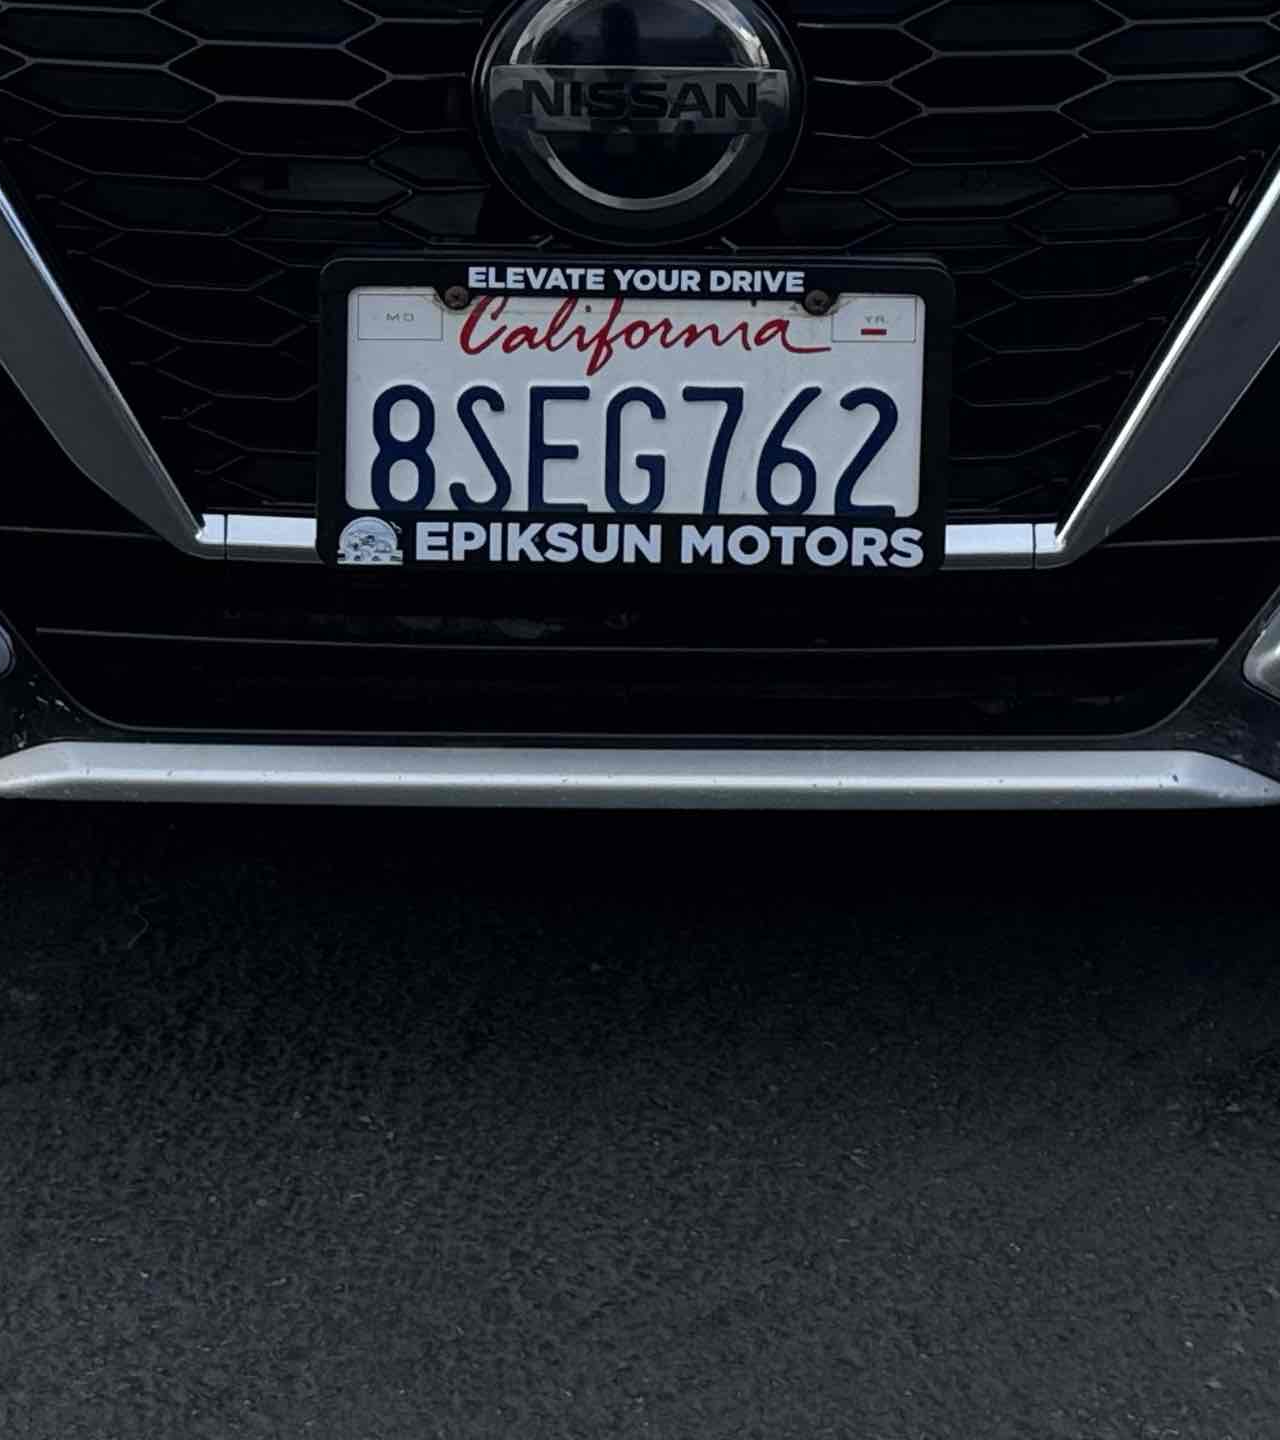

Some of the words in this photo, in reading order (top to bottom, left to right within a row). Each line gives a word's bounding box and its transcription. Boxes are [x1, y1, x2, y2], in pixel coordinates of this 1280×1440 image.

[521, 78, 759, 119] NISSAN
[467, 266, 606, 291] ELEVATE
[613, 269, 702, 293] YOUR
[709, 270, 806, 294] DRIVE
[459, 295, 832, 376] California
[369, 383, 899, 517] 8SEG762
[415, 521, 662, 564] EPIKSUN
[680, 525, 924, 568] MOTORS
